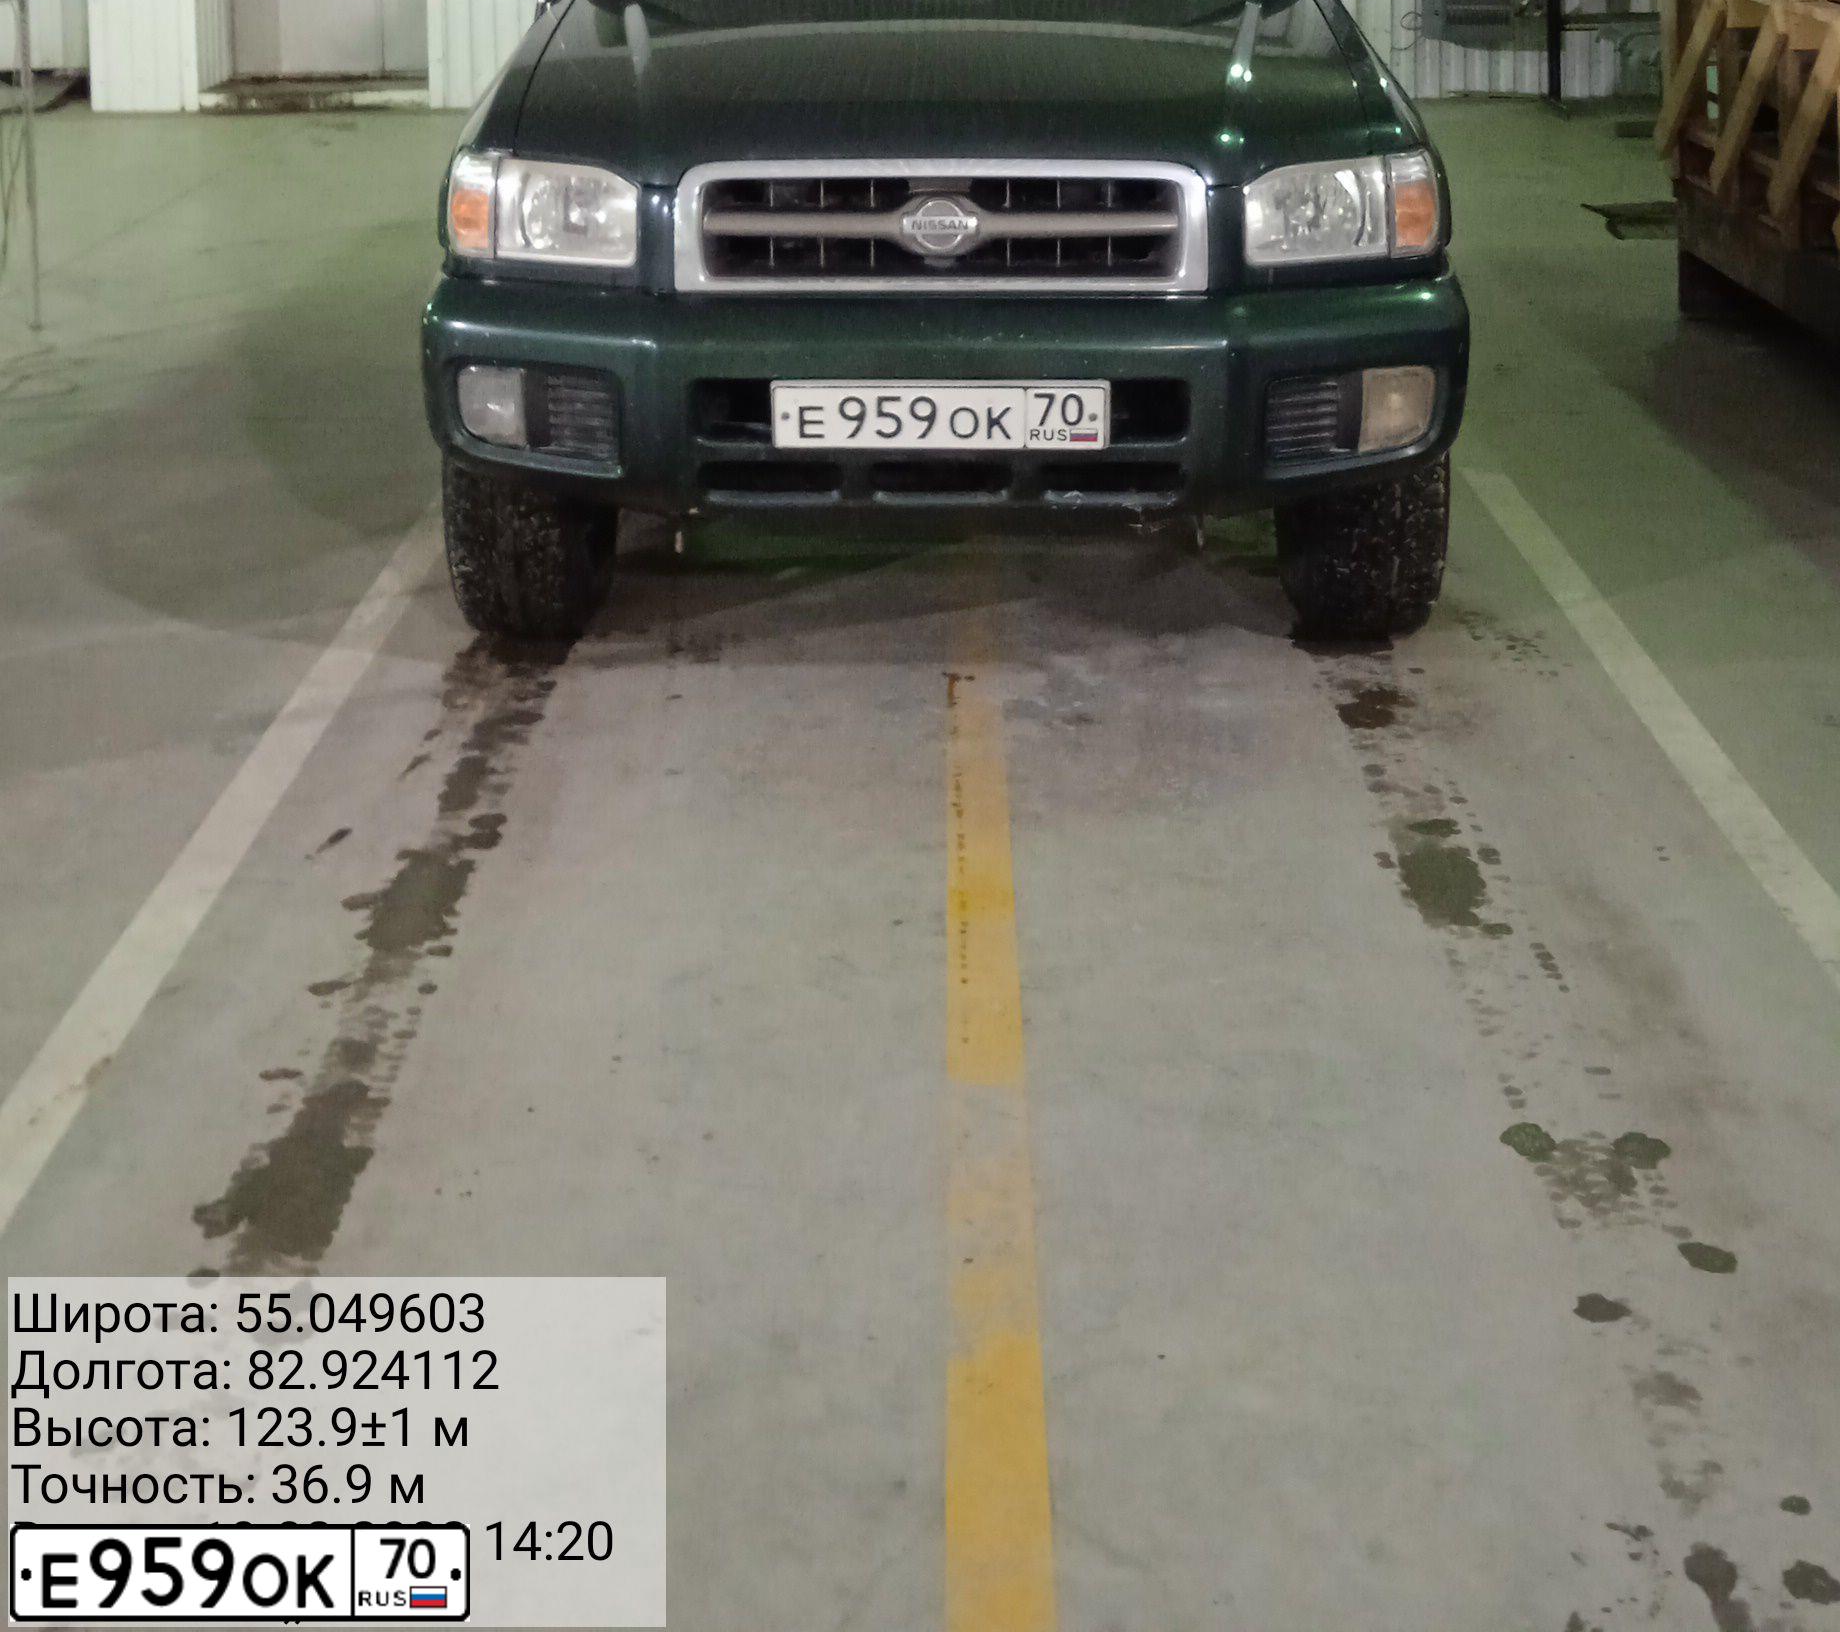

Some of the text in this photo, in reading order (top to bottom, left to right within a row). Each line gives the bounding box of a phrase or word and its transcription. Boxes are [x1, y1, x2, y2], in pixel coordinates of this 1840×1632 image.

[911, 218, 969, 230] NISSAN
[1033, 392, 1084, 427] 70
[1029, 428, 1068, 442] RUS
